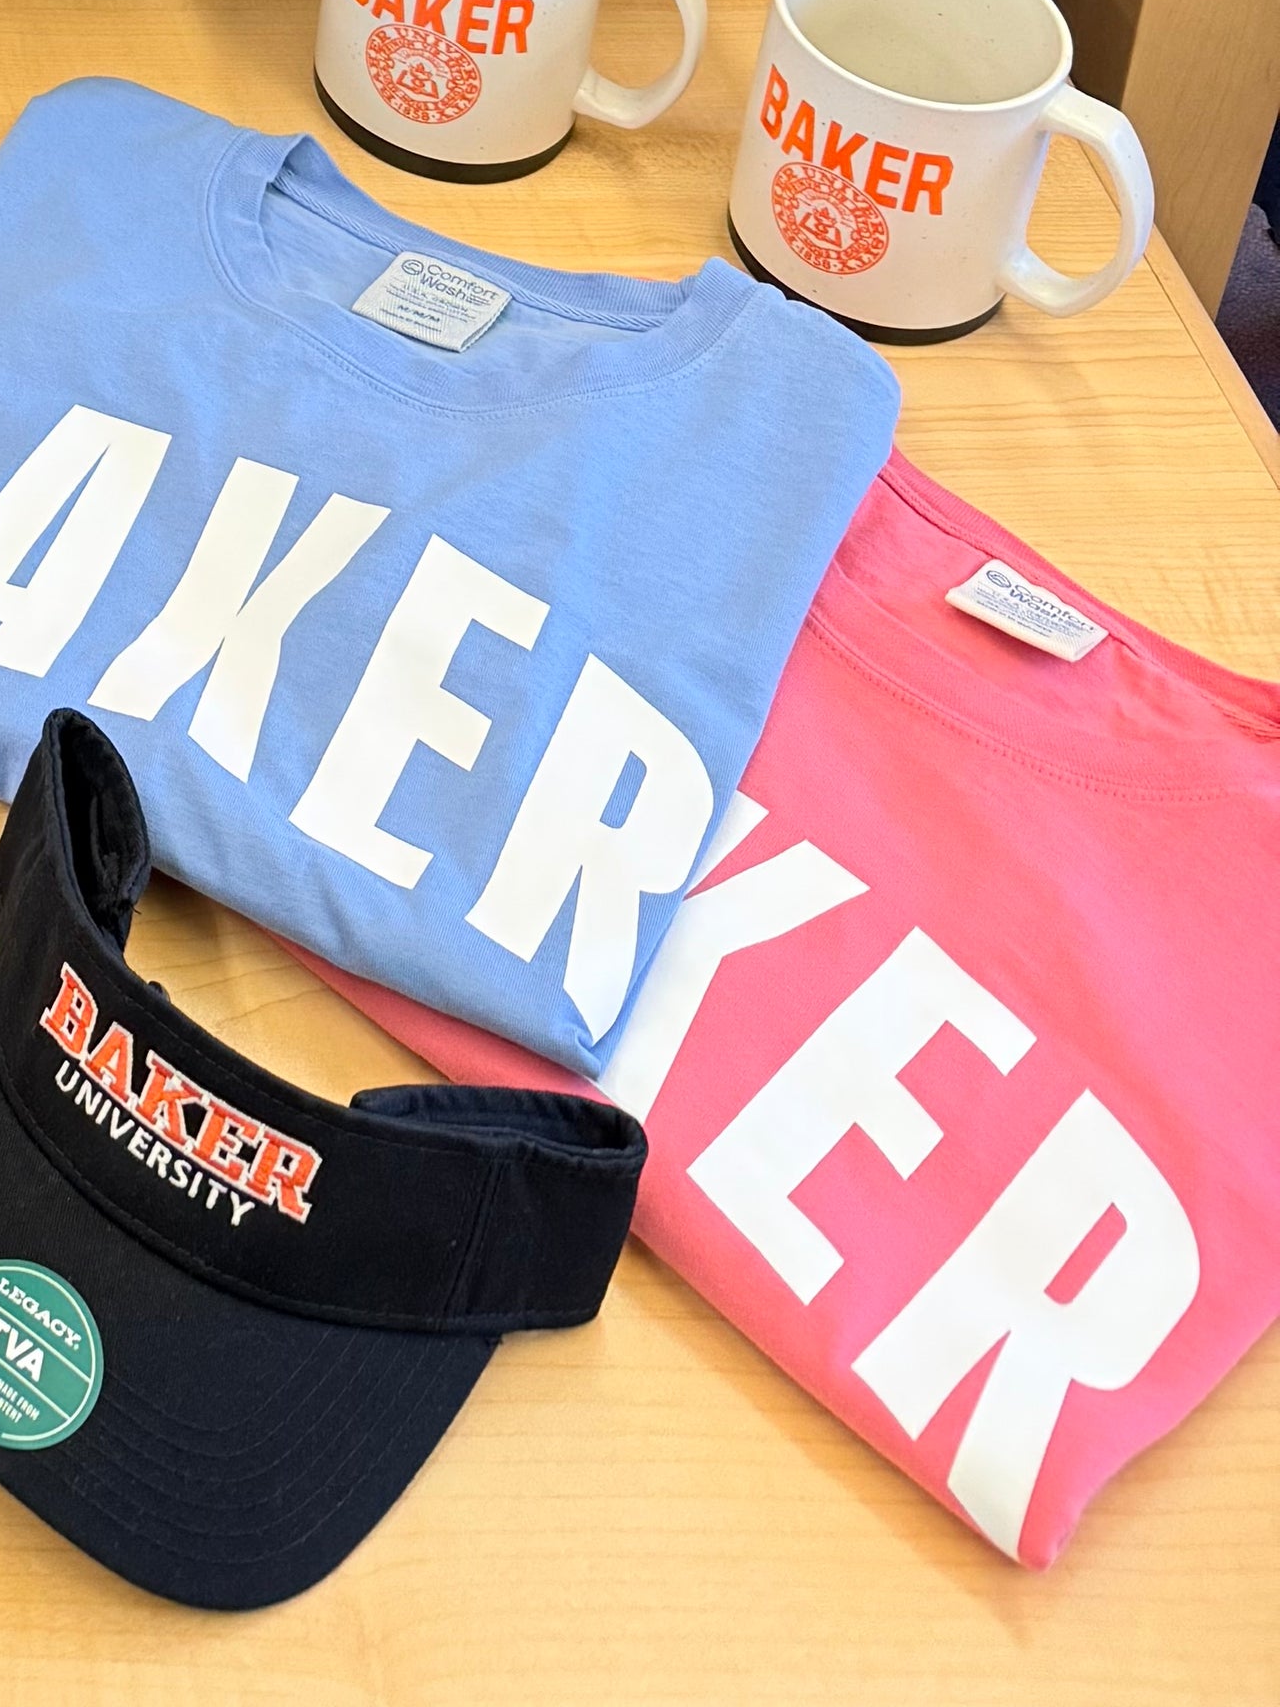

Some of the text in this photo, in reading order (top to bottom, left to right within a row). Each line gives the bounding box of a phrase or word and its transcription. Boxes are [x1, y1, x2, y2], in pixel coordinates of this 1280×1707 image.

[396, 99, 432, 122] 1858
[760, 63, 954, 216] BAKER
[798, 246, 832, 271] 1858
[420, 274, 467, 303] Wash
[427, 263, 500, 301] Comfort
[1013, 584, 1096, 634] Comfort
[39, 961, 324, 1225] BAKER
[54, 1060, 256, 1227] UNIVERSITY
[598, 790, 1202, 1565] KER
[17, 1393, 40, 1422] FROM
